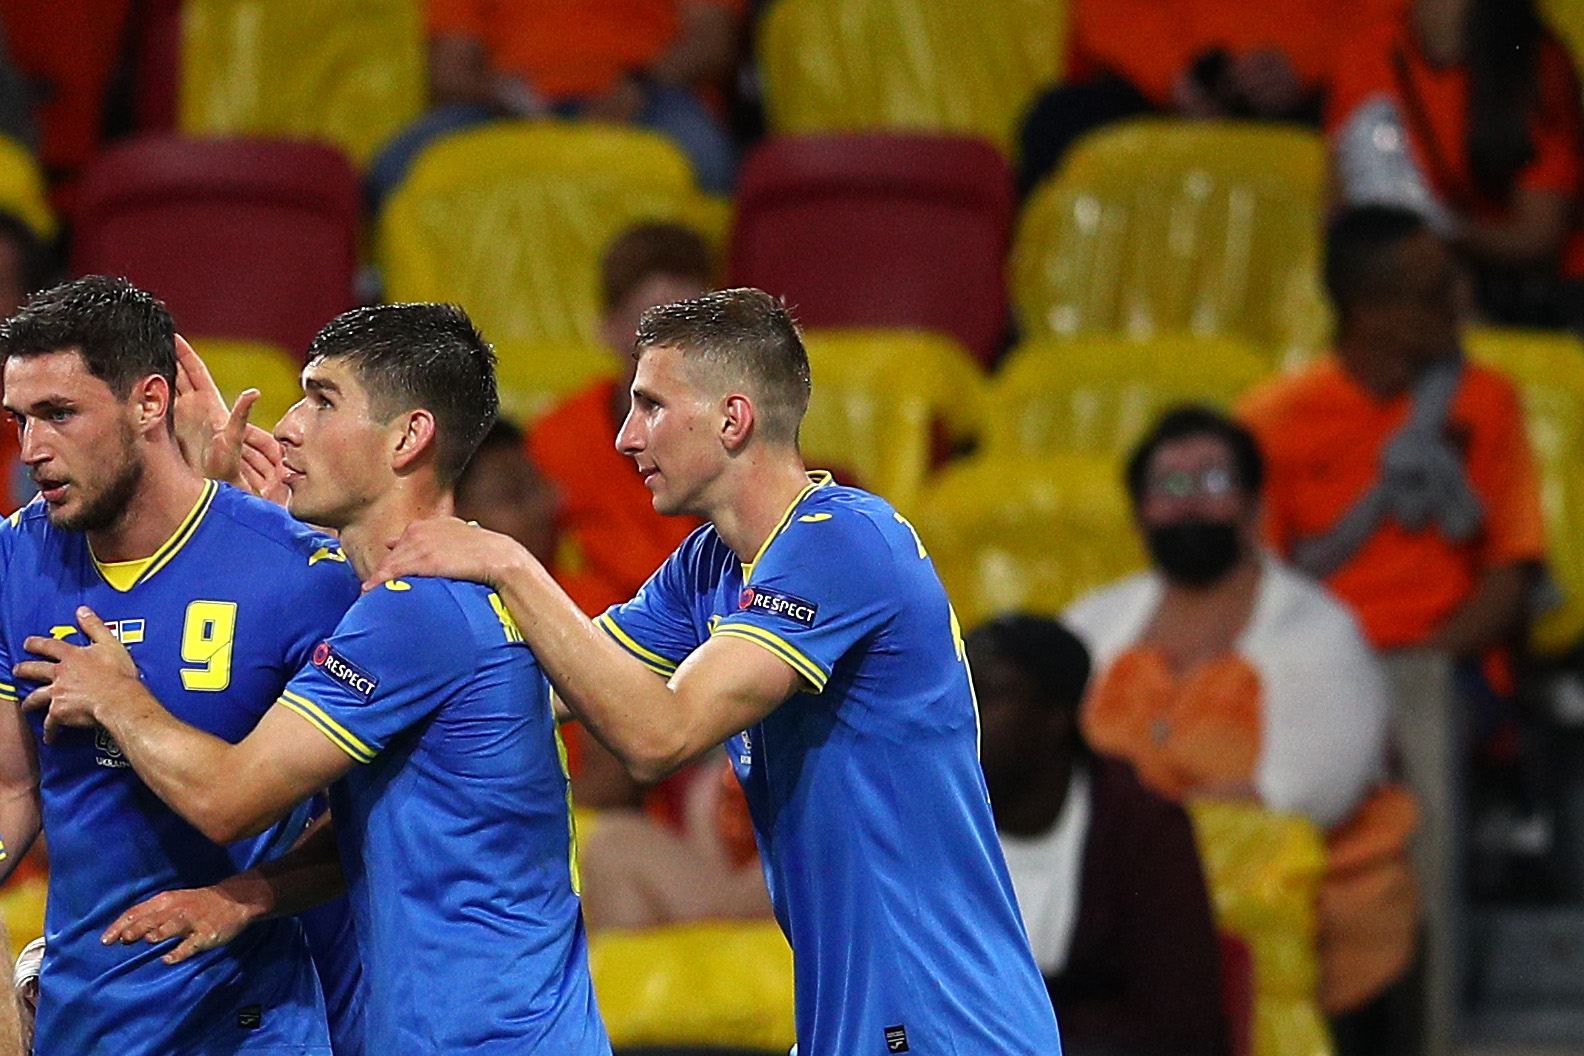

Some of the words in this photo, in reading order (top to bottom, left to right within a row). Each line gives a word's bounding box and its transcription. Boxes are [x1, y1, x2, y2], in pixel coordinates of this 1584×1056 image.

[753, 593, 815, 622] RESPECT
[180, 600, 238, 692] 9
[324, 655, 375, 695] RESPECT
